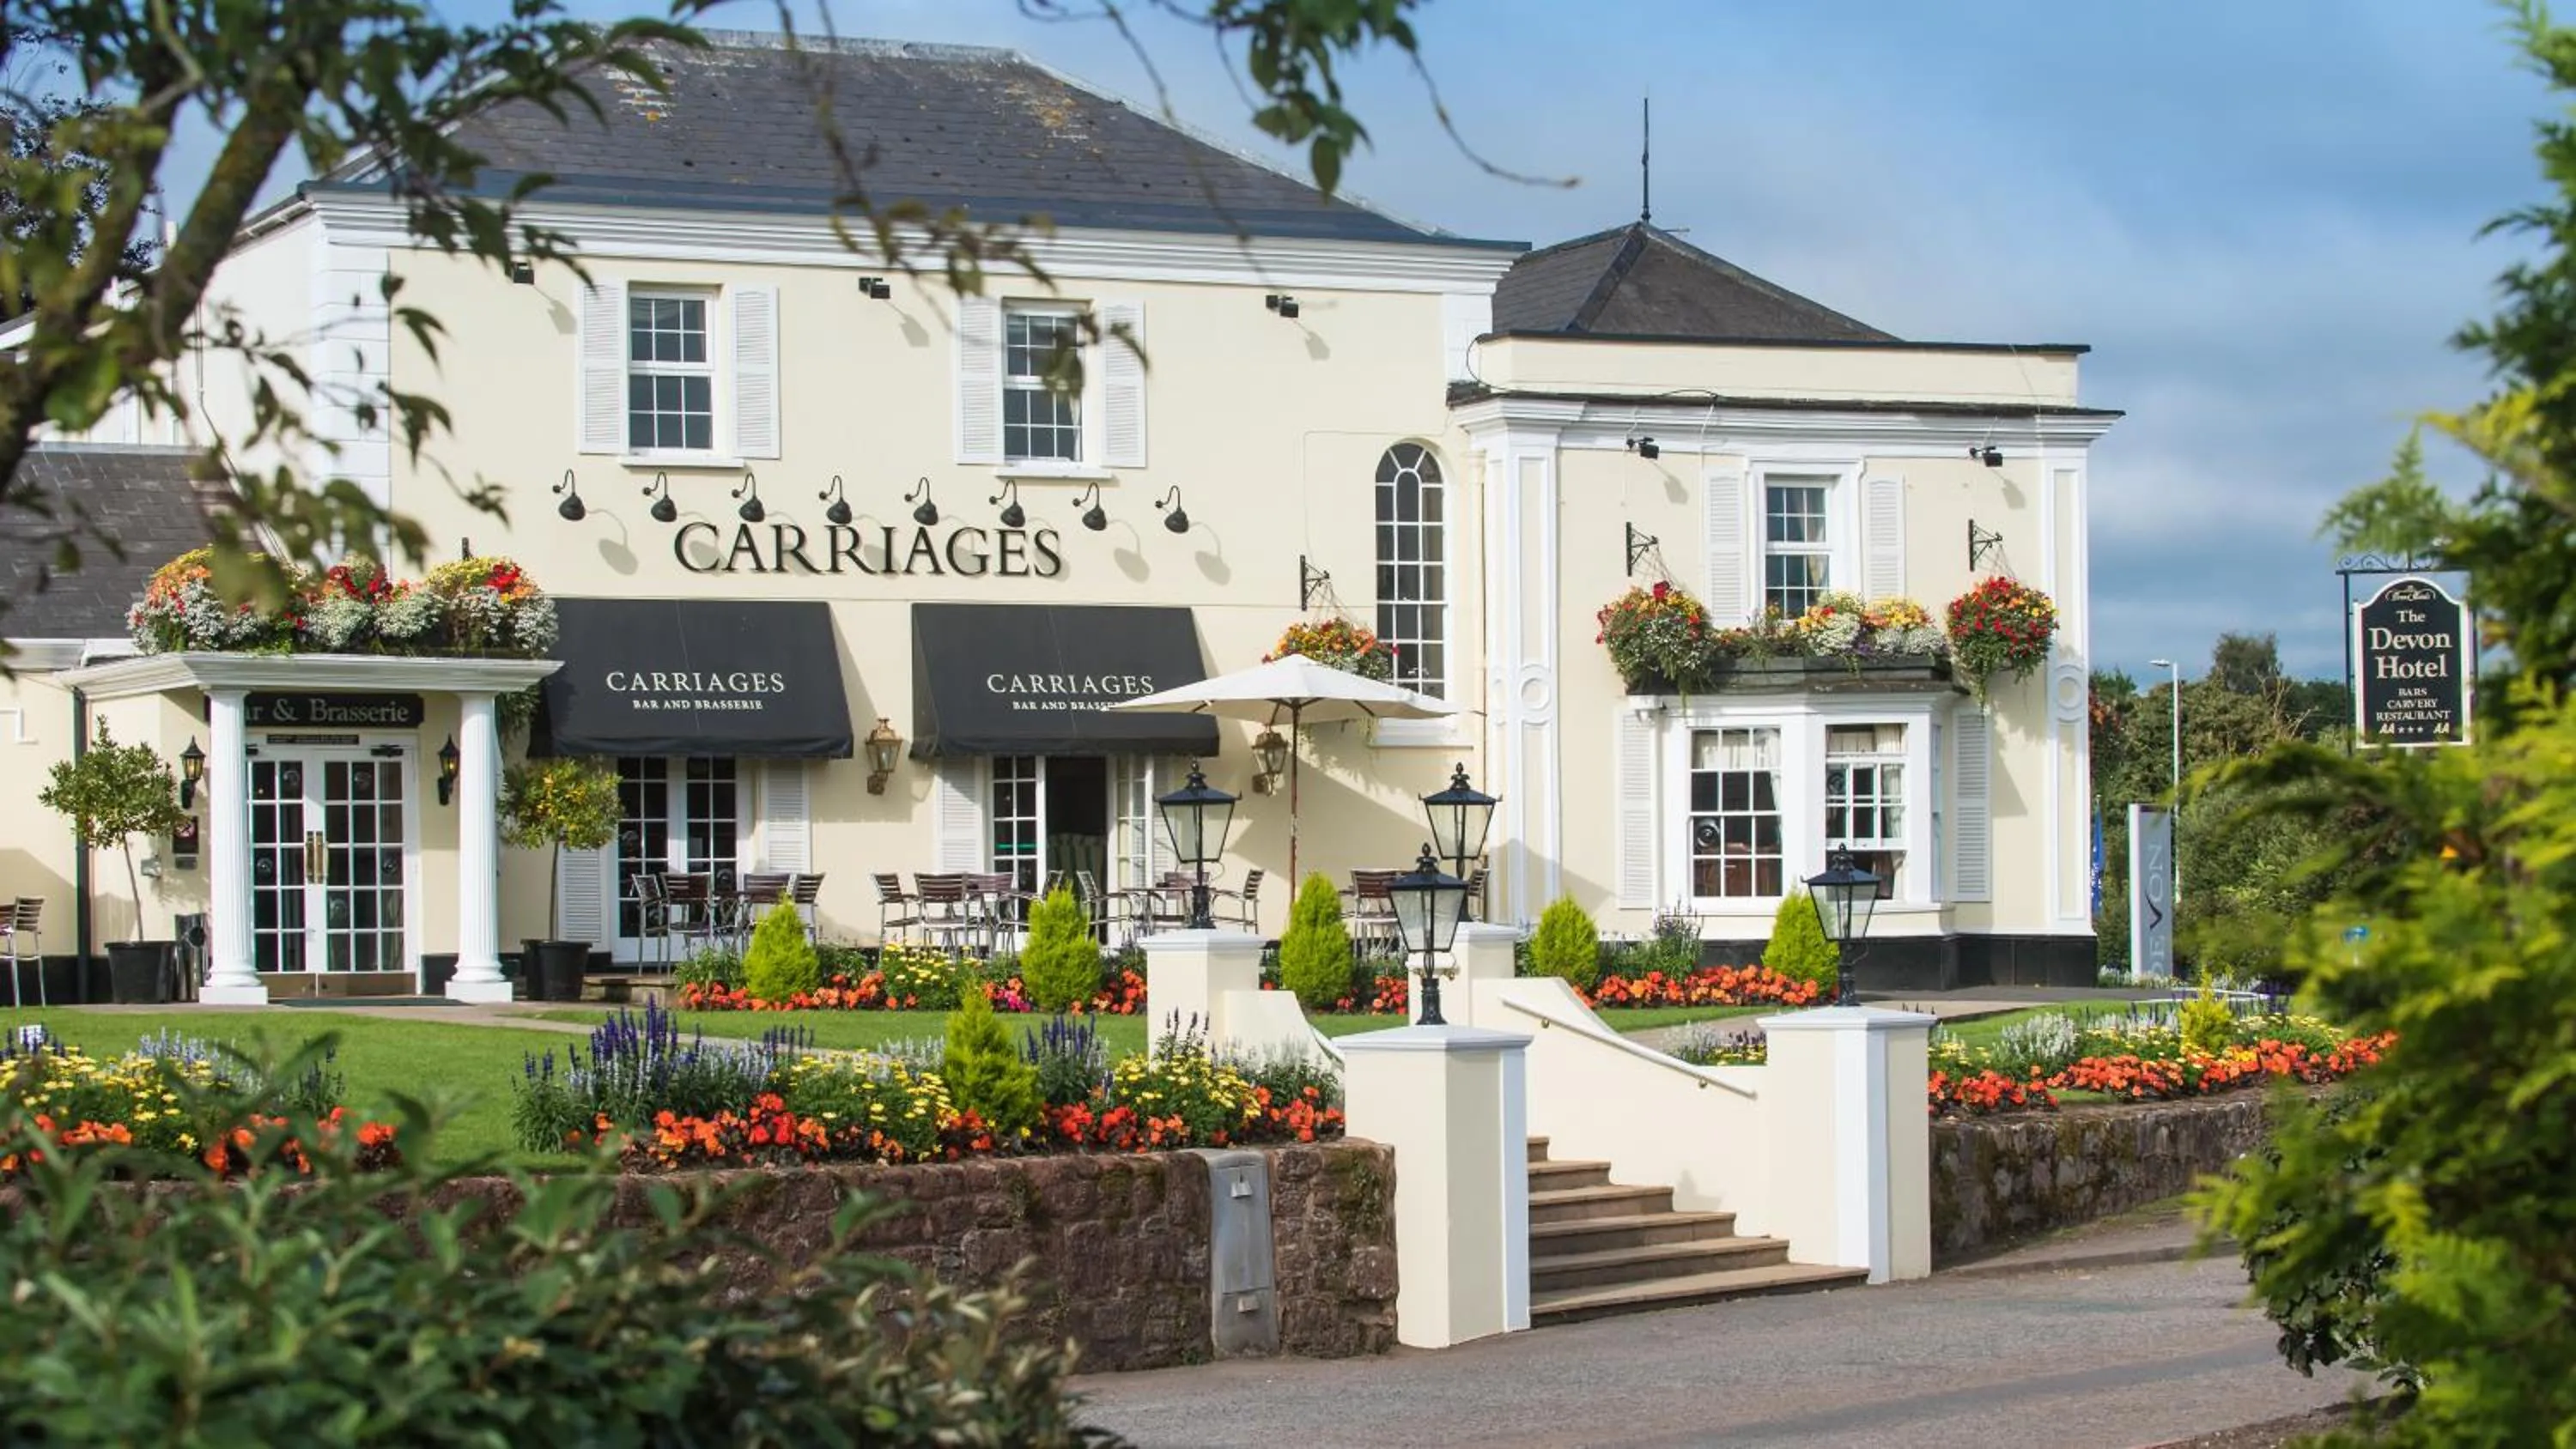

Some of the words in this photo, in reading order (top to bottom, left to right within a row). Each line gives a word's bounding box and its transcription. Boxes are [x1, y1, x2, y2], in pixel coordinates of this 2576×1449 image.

[674, 522, 1061, 577] CARRIAGES
[2396, 609, 2426, 622] The
[2369, 627, 2452, 650] Devon
[2375, 654, 2449, 679] Hotel
[605, 671, 785, 693] CARRIAGES
[987, 674, 1154, 694] CARRIAGES
[2397, 688, 2427, 696] BARS
[272, 698, 298, 722] &
[308, 699, 410, 722] Brasserie
[632, 700, 659, 709] BAR
[663, 700, 690, 709] AND
[694, 700, 763, 710] BRASSERIE
[1013, 701, 1037, 710] BAR
[1041, 701, 1067, 710] AND
[2386, 699, 2438, 709] CARVERY
[2376, 710, 2451, 721] RESTAURANT
